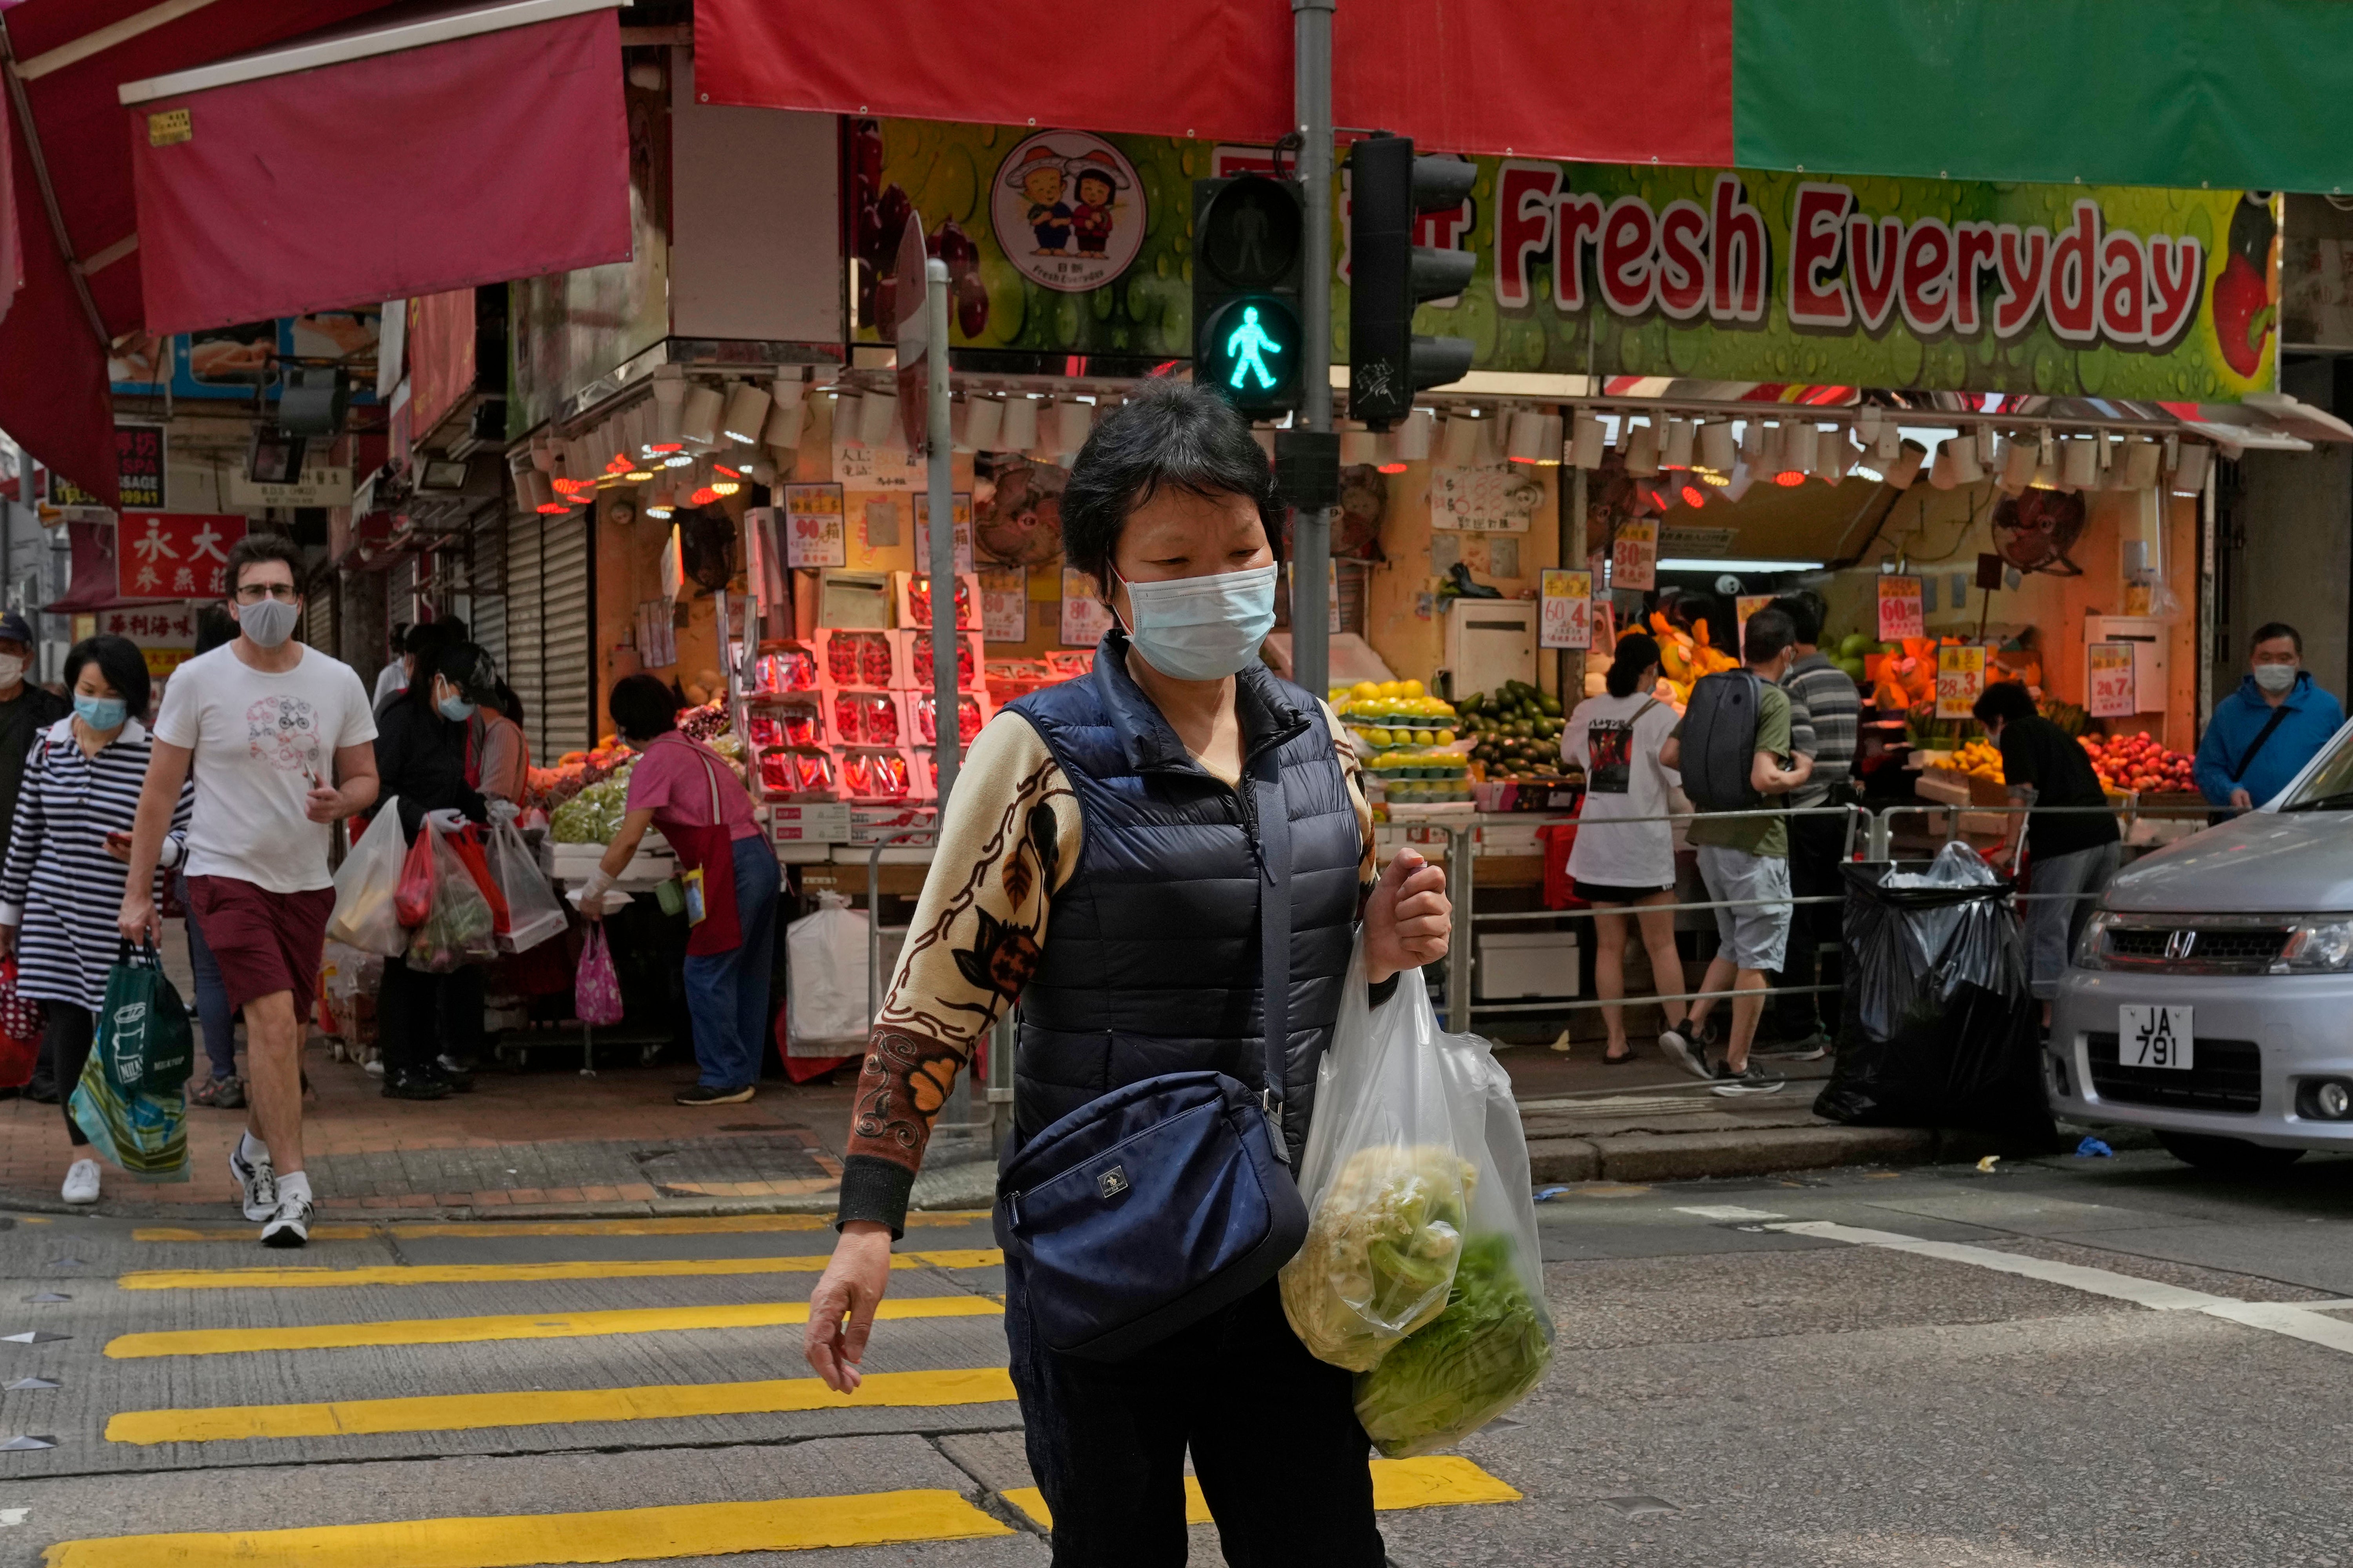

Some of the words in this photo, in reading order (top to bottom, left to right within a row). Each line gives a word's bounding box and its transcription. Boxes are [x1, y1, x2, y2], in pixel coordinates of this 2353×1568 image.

[1495, 159, 1766, 322] Fresh
[1788, 182, 2202, 347] Everyday
[133, 518, 229, 563] 永大
[796, 519, 819, 539] 90
[1615, 541, 1640, 567] 30
[1546, 600, 1565, 622] 60
[1571, 602, 1584, 627] 4
[1881, 598, 1906, 621] 60
[1938, 678, 1957, 696] 28
[1964, 671, 1976, 696] 3
[2097, 681, 2113, 696] 20
[2115, 678, 2128, 696] 7
[2141, 1007, 2171, 1036] JA
[2136, 1036, 2177, 1066] 791
